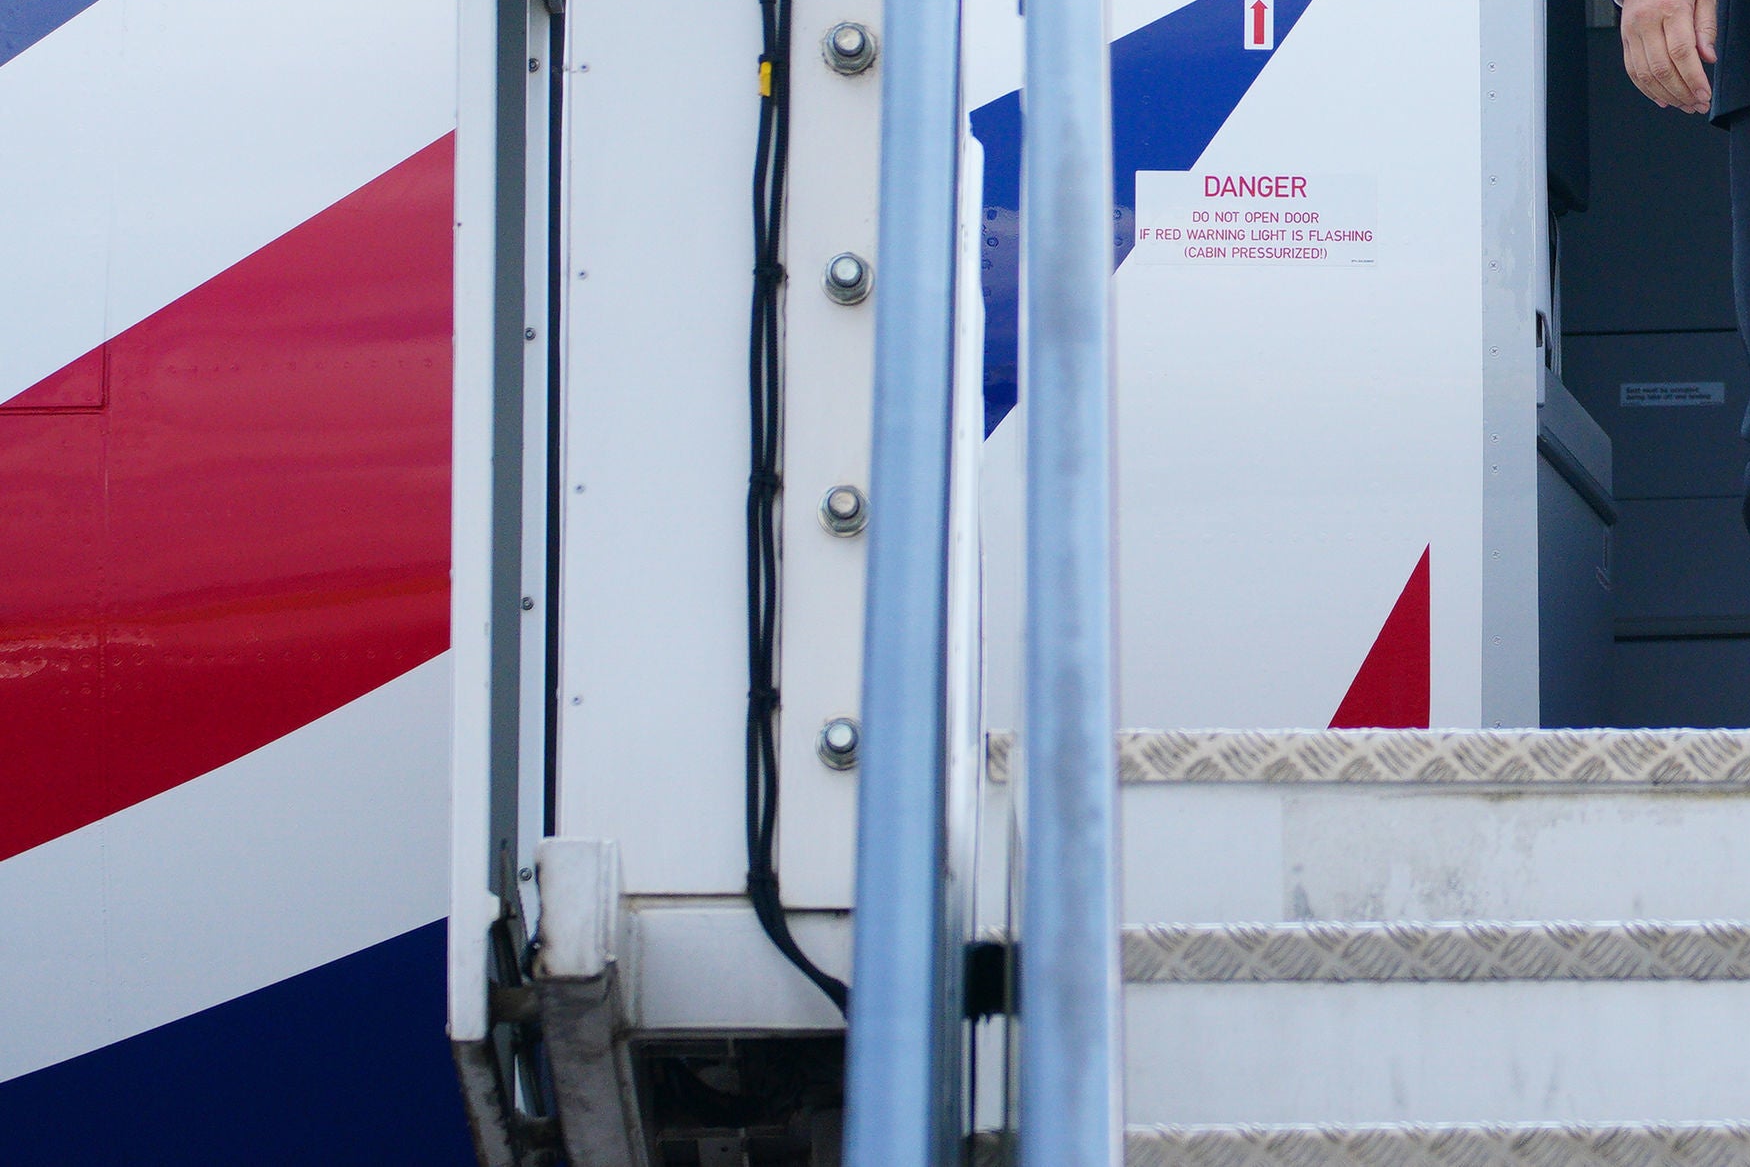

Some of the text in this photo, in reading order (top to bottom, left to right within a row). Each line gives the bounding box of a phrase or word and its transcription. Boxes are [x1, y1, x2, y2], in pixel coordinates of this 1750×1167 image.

[1204, 175, 1307, 198] DANGER
[1192, 211, 1320, 224] DO NOT OPEN DOOR
[1139, 228, 1373, 242] IF RED WARNING LIGHT IS FLASHING
[1184, 246, 1328, 260] (CABIN PRESSURIZED!)
